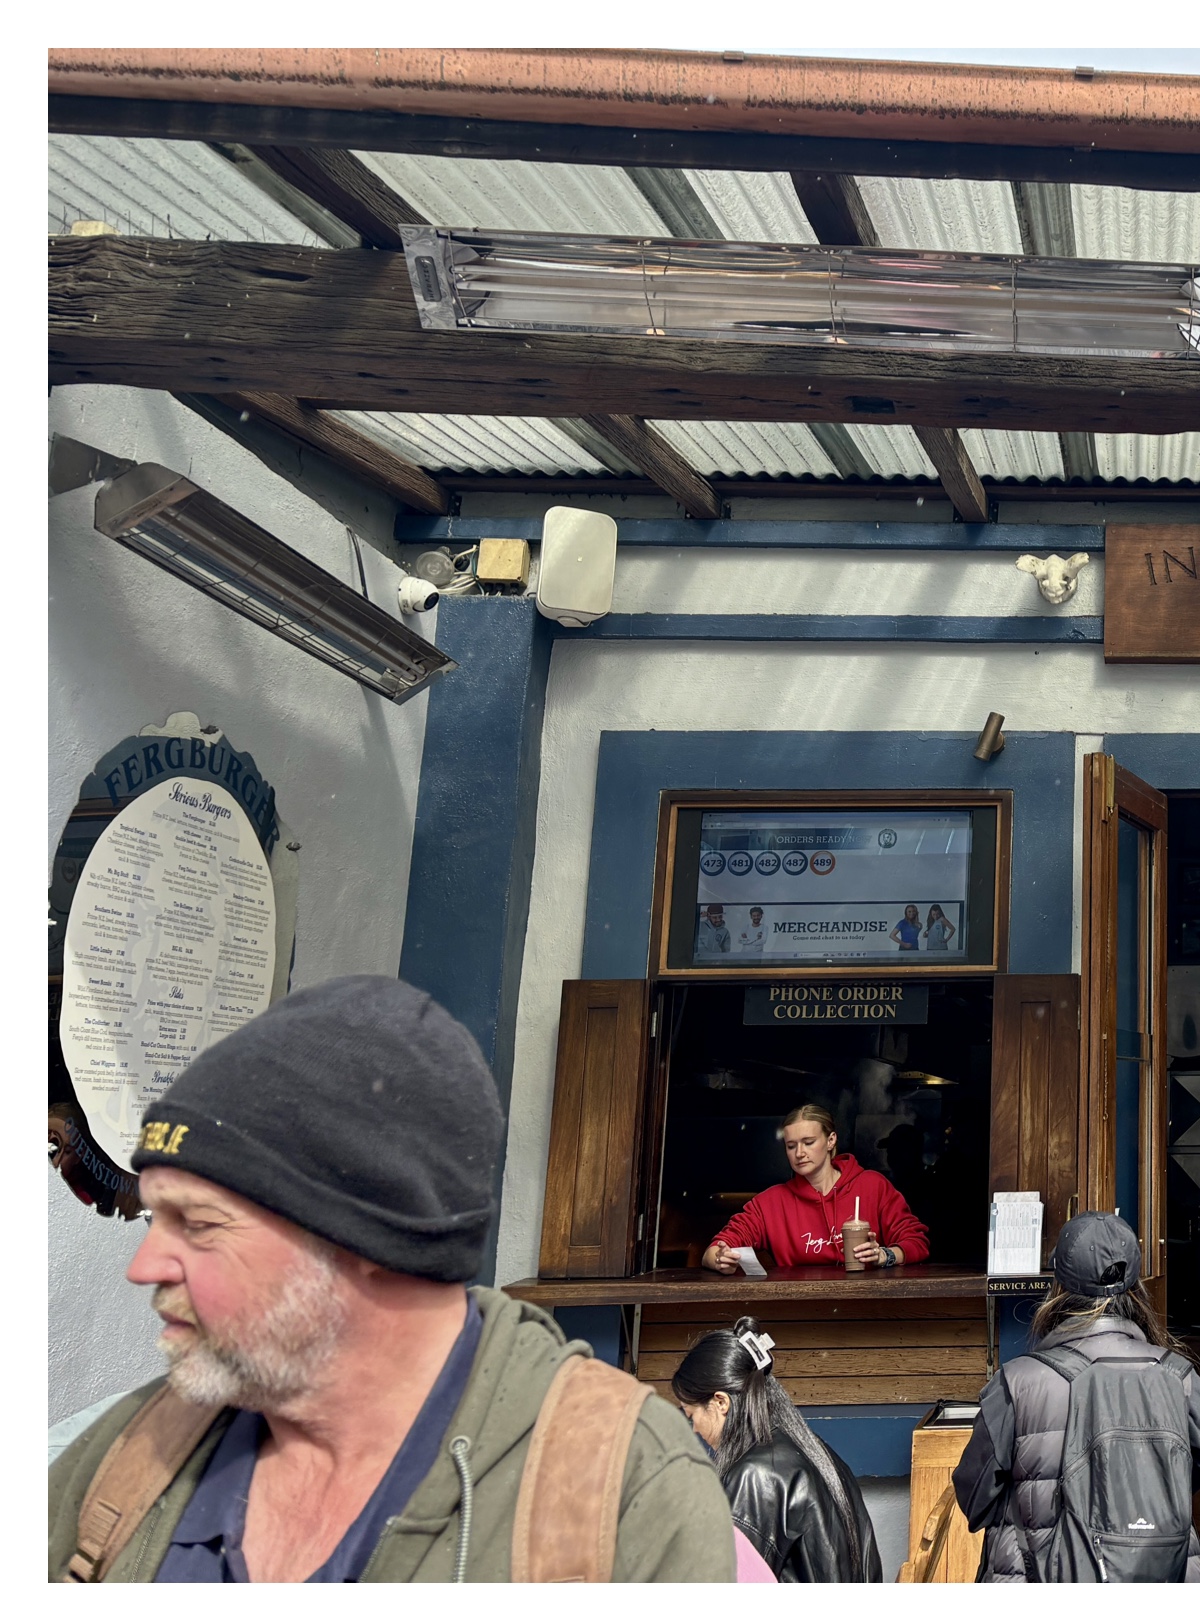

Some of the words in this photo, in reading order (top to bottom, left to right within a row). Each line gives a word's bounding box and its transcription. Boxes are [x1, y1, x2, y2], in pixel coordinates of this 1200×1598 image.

[1143, 546, 1198, 586] IN
[104, 736, 280, 857] FERGBURGER
[168, 782, 199, 808] Serious
[199, 792, 232, 821] Burgers
[776, 835, 814, 844] ORDERS
[816, 835, 846, 844] READY
[704, 859, 723, 868] 473
[732, 859, 750, 867] 481
[758, 859, 777, 867] 482
[786, 858, 804, 867] 487
[813, 858, 832, 867] 489
[773, 920, 888, 933] MERCHANDISE
[768, 987, 834, 1001] PHONE
[838, 986, 904, 1001] ORDER
[773, 1004, 897, 1019] COLLECTION
[801, 1232, 826, 1254] Ferg
[988, 1282, 1026, 1291] SERVICE
[1028, 1282, 1052, 1290] AREA
